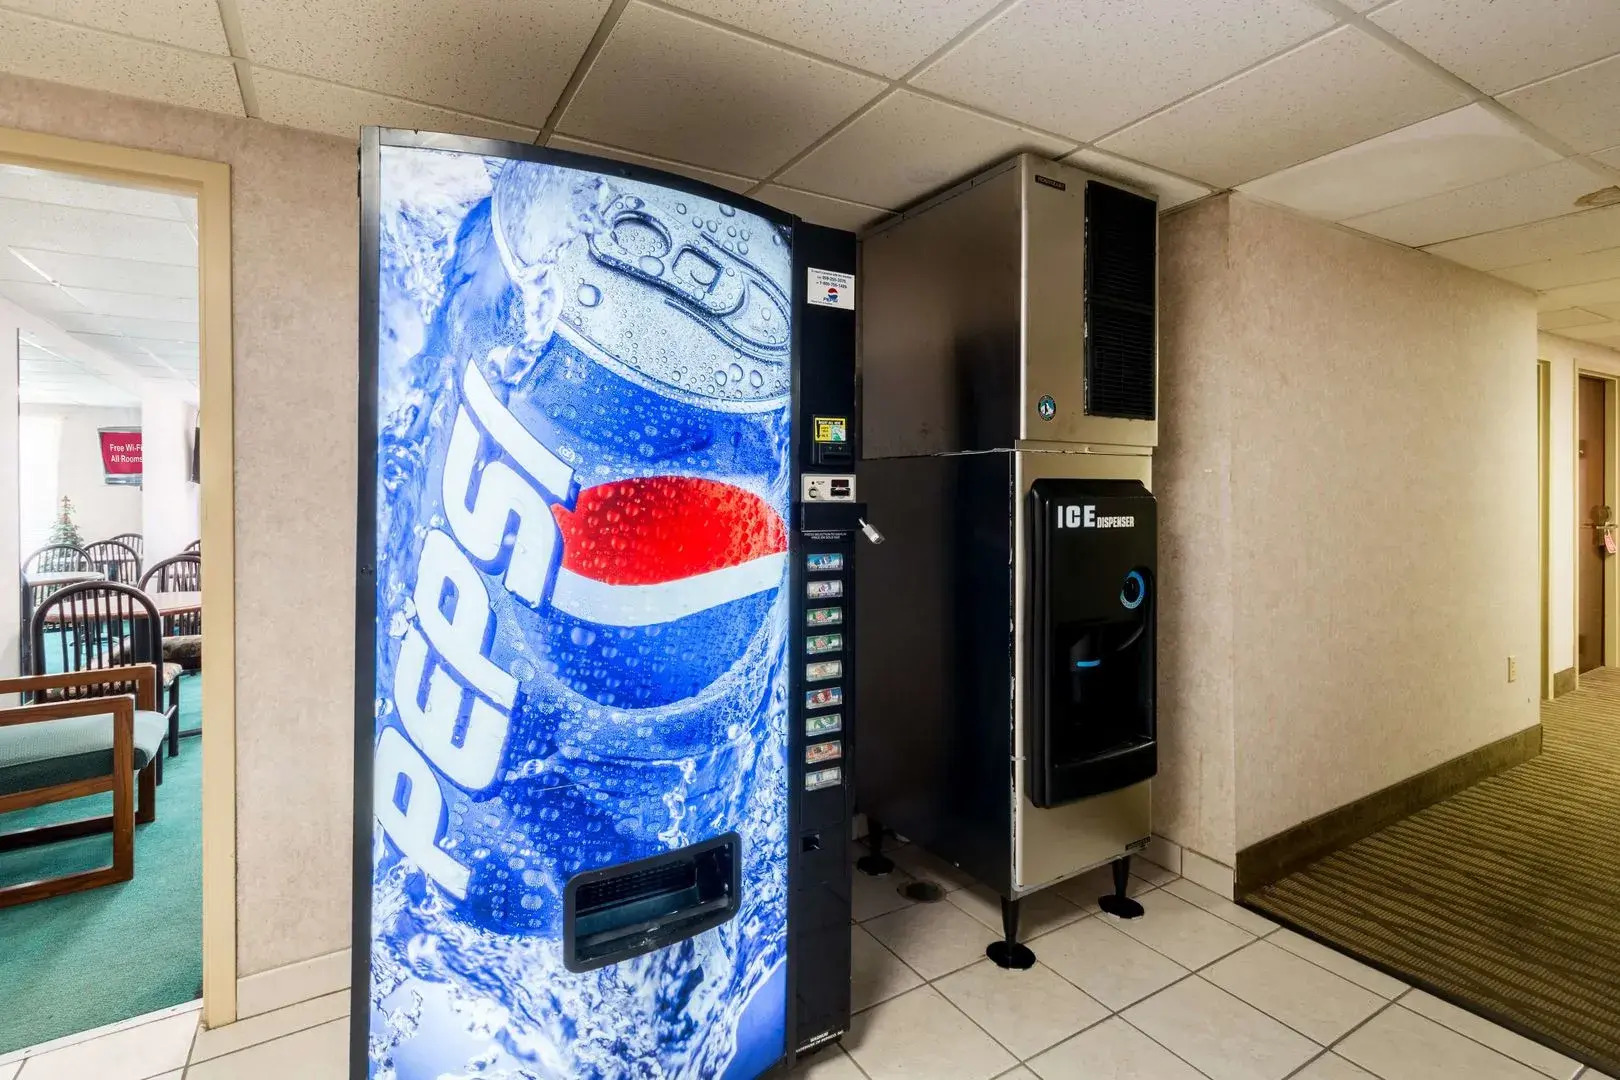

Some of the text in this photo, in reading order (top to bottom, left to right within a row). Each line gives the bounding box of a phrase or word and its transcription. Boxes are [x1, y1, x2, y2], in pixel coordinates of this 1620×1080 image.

[109, 443, 125, 452] Free
[111, 454, 143, 463] All Rooms
[1057, 504, 1135, 529] ICE DISPENSER
[374, 357, 576, 901] PEPSI
